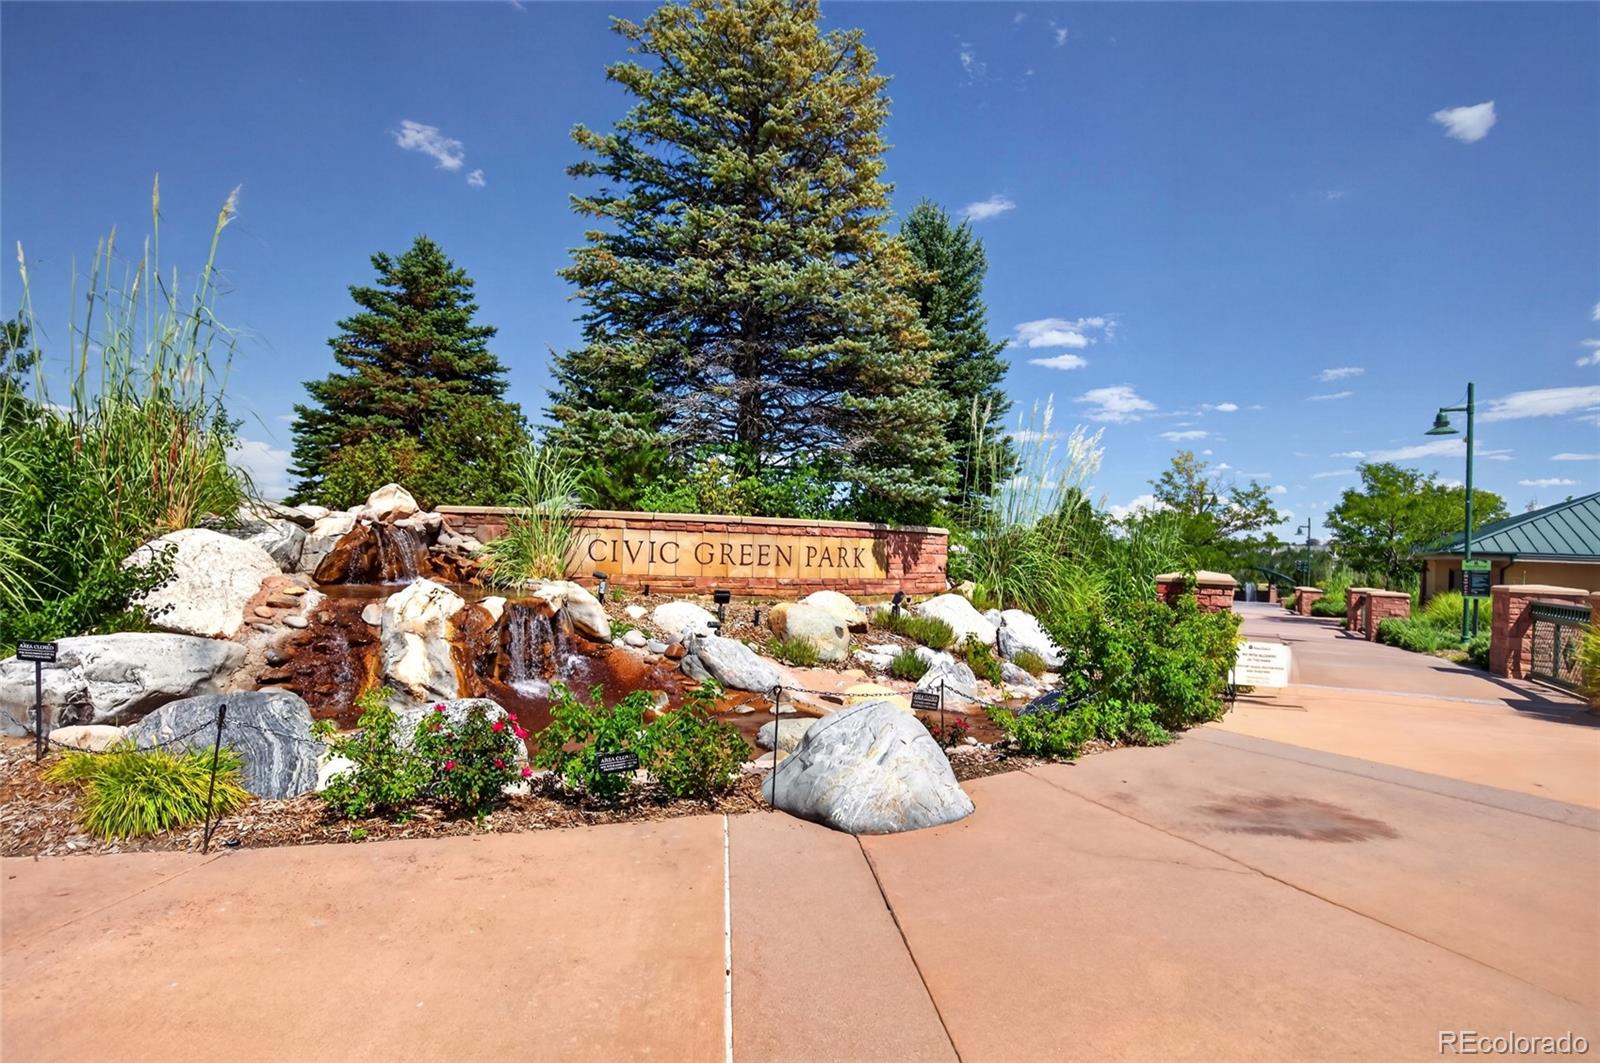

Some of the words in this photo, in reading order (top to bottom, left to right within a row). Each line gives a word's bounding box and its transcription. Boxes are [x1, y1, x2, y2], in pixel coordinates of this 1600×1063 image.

[588, 538, 680, 565] CIVIC
[694, 541, 793, 568] GREEN
[804, 544, 866, 569] PARK
